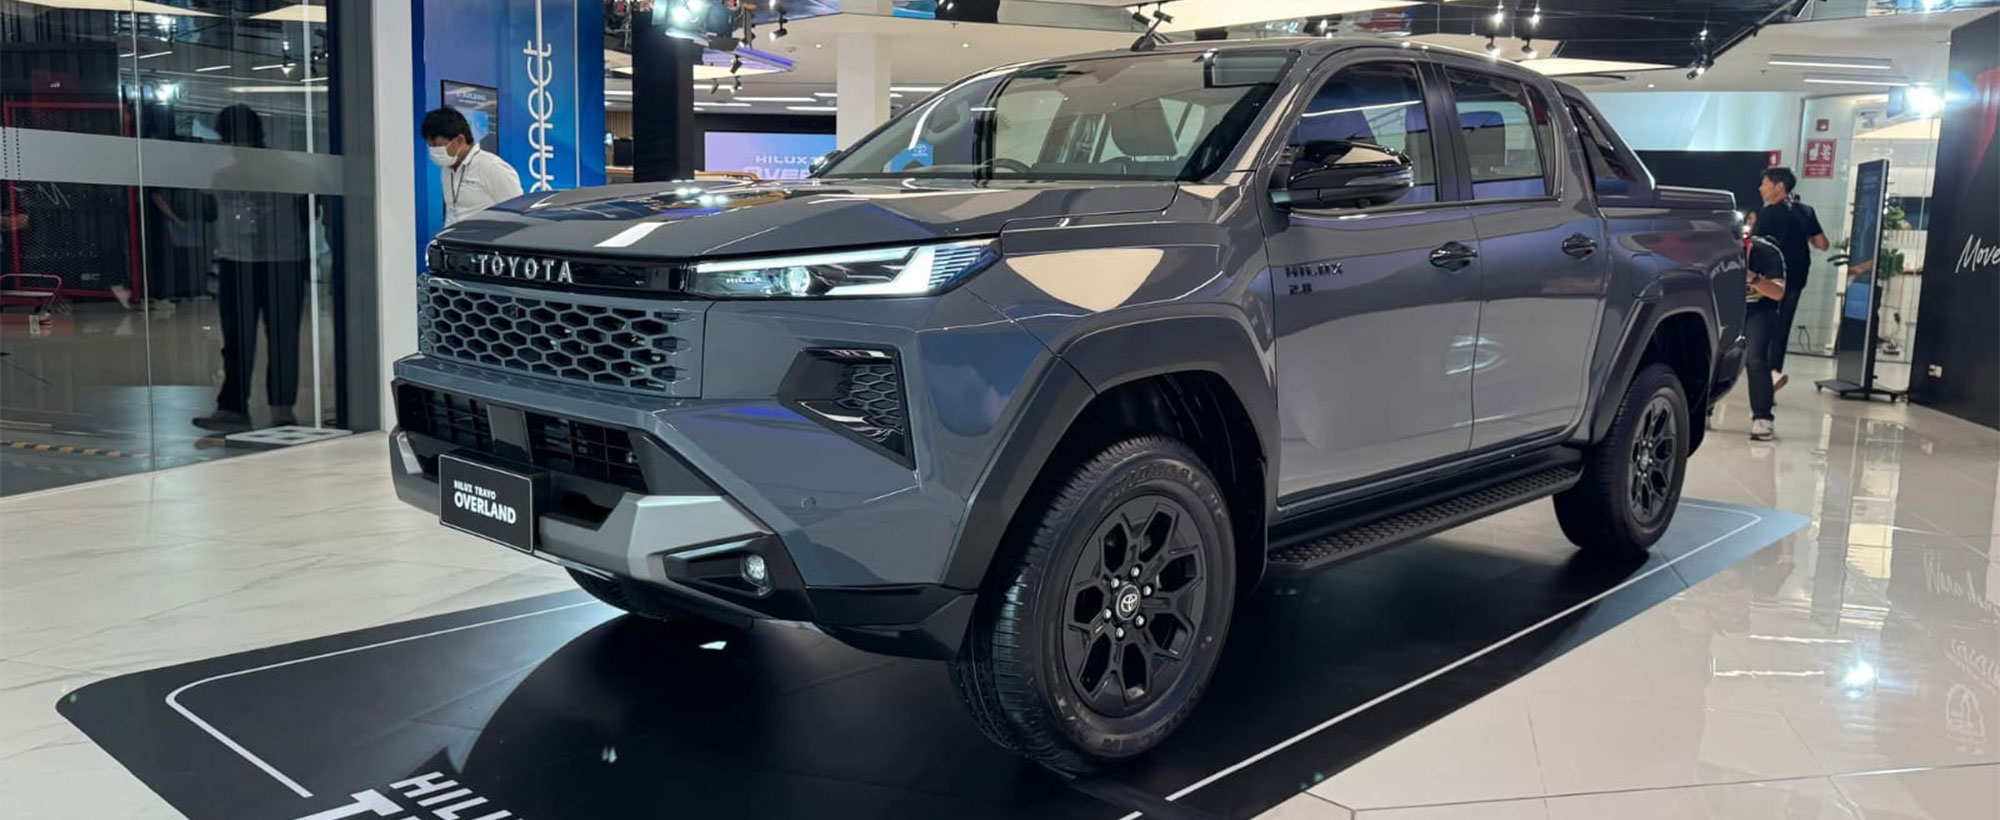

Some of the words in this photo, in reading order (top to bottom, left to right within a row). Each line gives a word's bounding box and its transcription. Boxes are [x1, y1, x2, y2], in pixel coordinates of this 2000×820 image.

[756, 155, 807, 164] HILUX
[1955, 234, 2000, 273] Move
[478, 254, 572, 283] TOYOTA
[1286, 263, 1342, 277] HILUX
[453, 480, 473, 493] HILUX
[475, 486, 497, 500] TRAVO
[454, 491, 516, 524] OVERLAND
[389, 771, 525, 820] HIL
